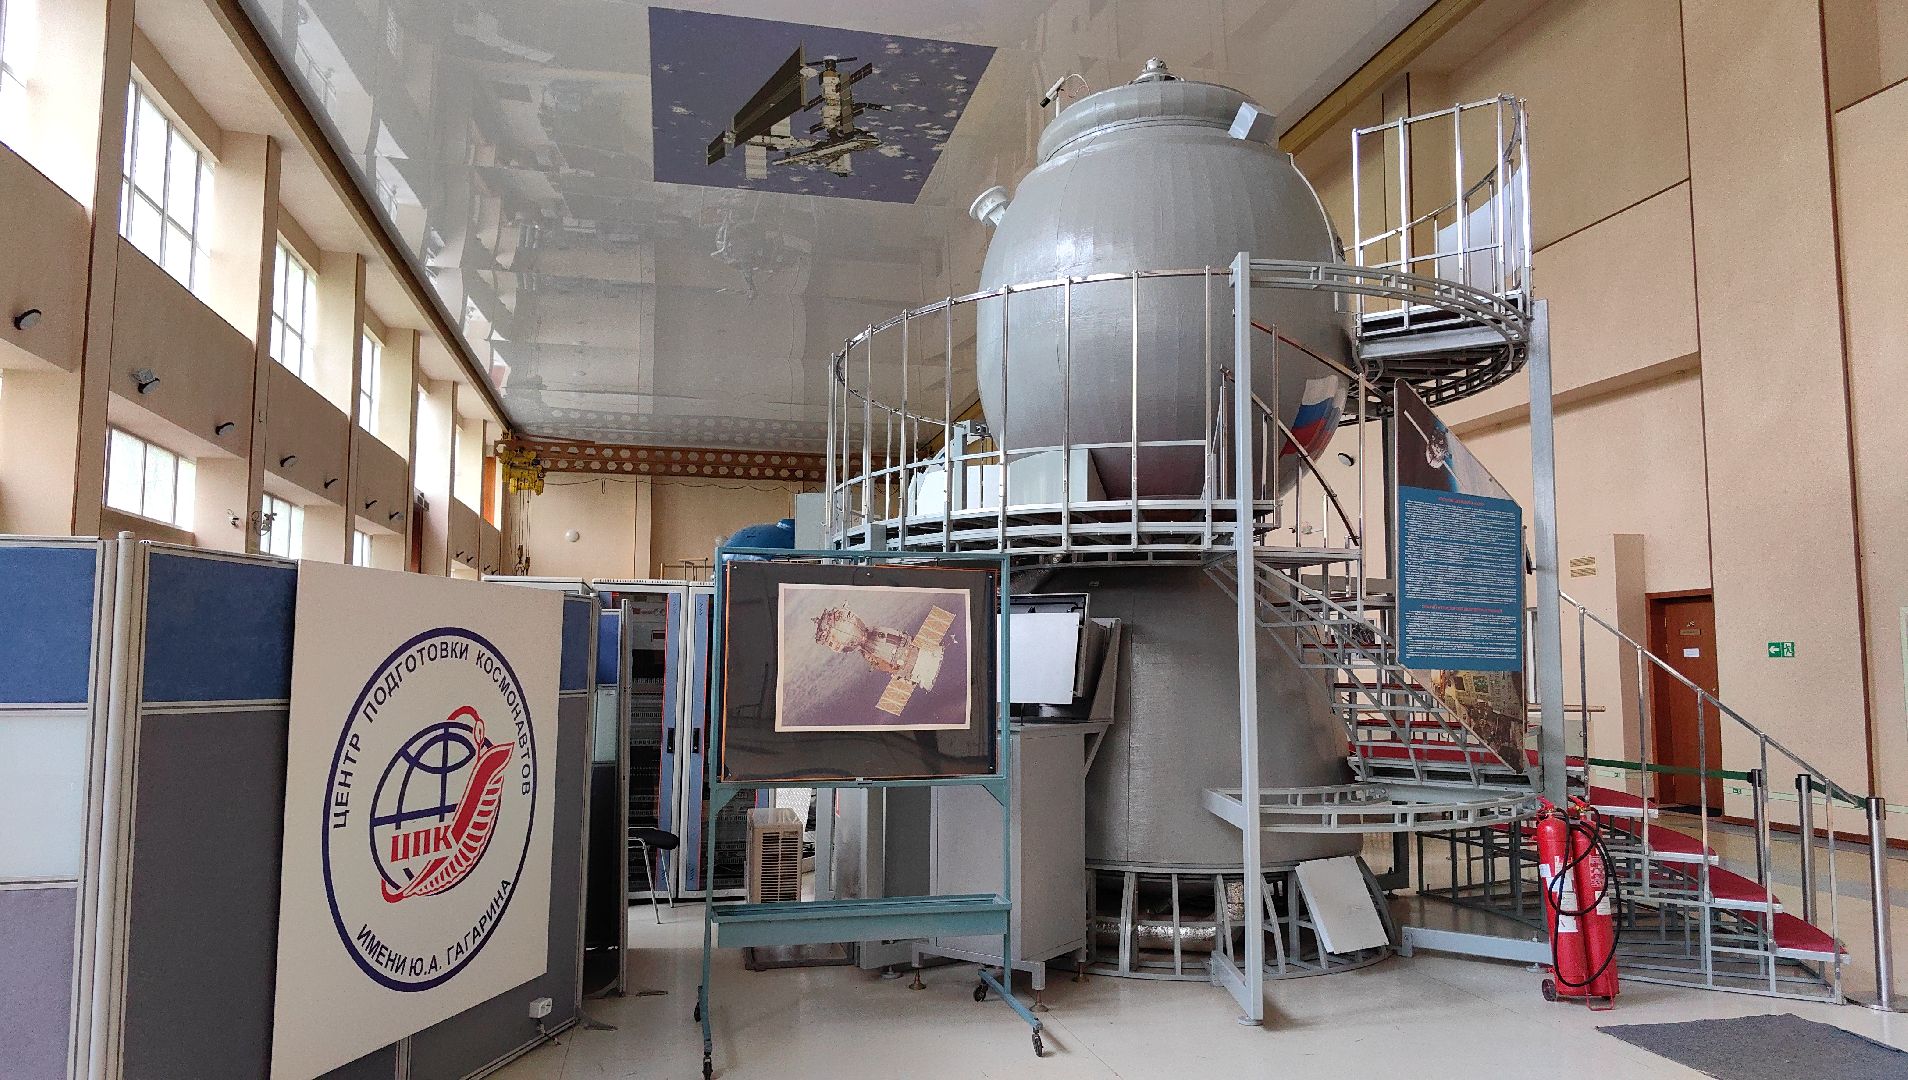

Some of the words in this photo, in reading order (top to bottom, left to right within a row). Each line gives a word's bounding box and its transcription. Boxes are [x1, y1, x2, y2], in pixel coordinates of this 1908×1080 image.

[333, 733, 361, 829] ЦЕНТР
[362, 641, 469, 723] ПОДГОТОВКИ
[475, 650, 531, 796] КОСМОНАВТОВ
[390, 824, 453, 863] ЦПК
[356, 923, 406, 976] ИМЕНИ
[408, 954, 442, 977] Ю.А.
[447, 879, 512, 966] ГАГАРИНА
